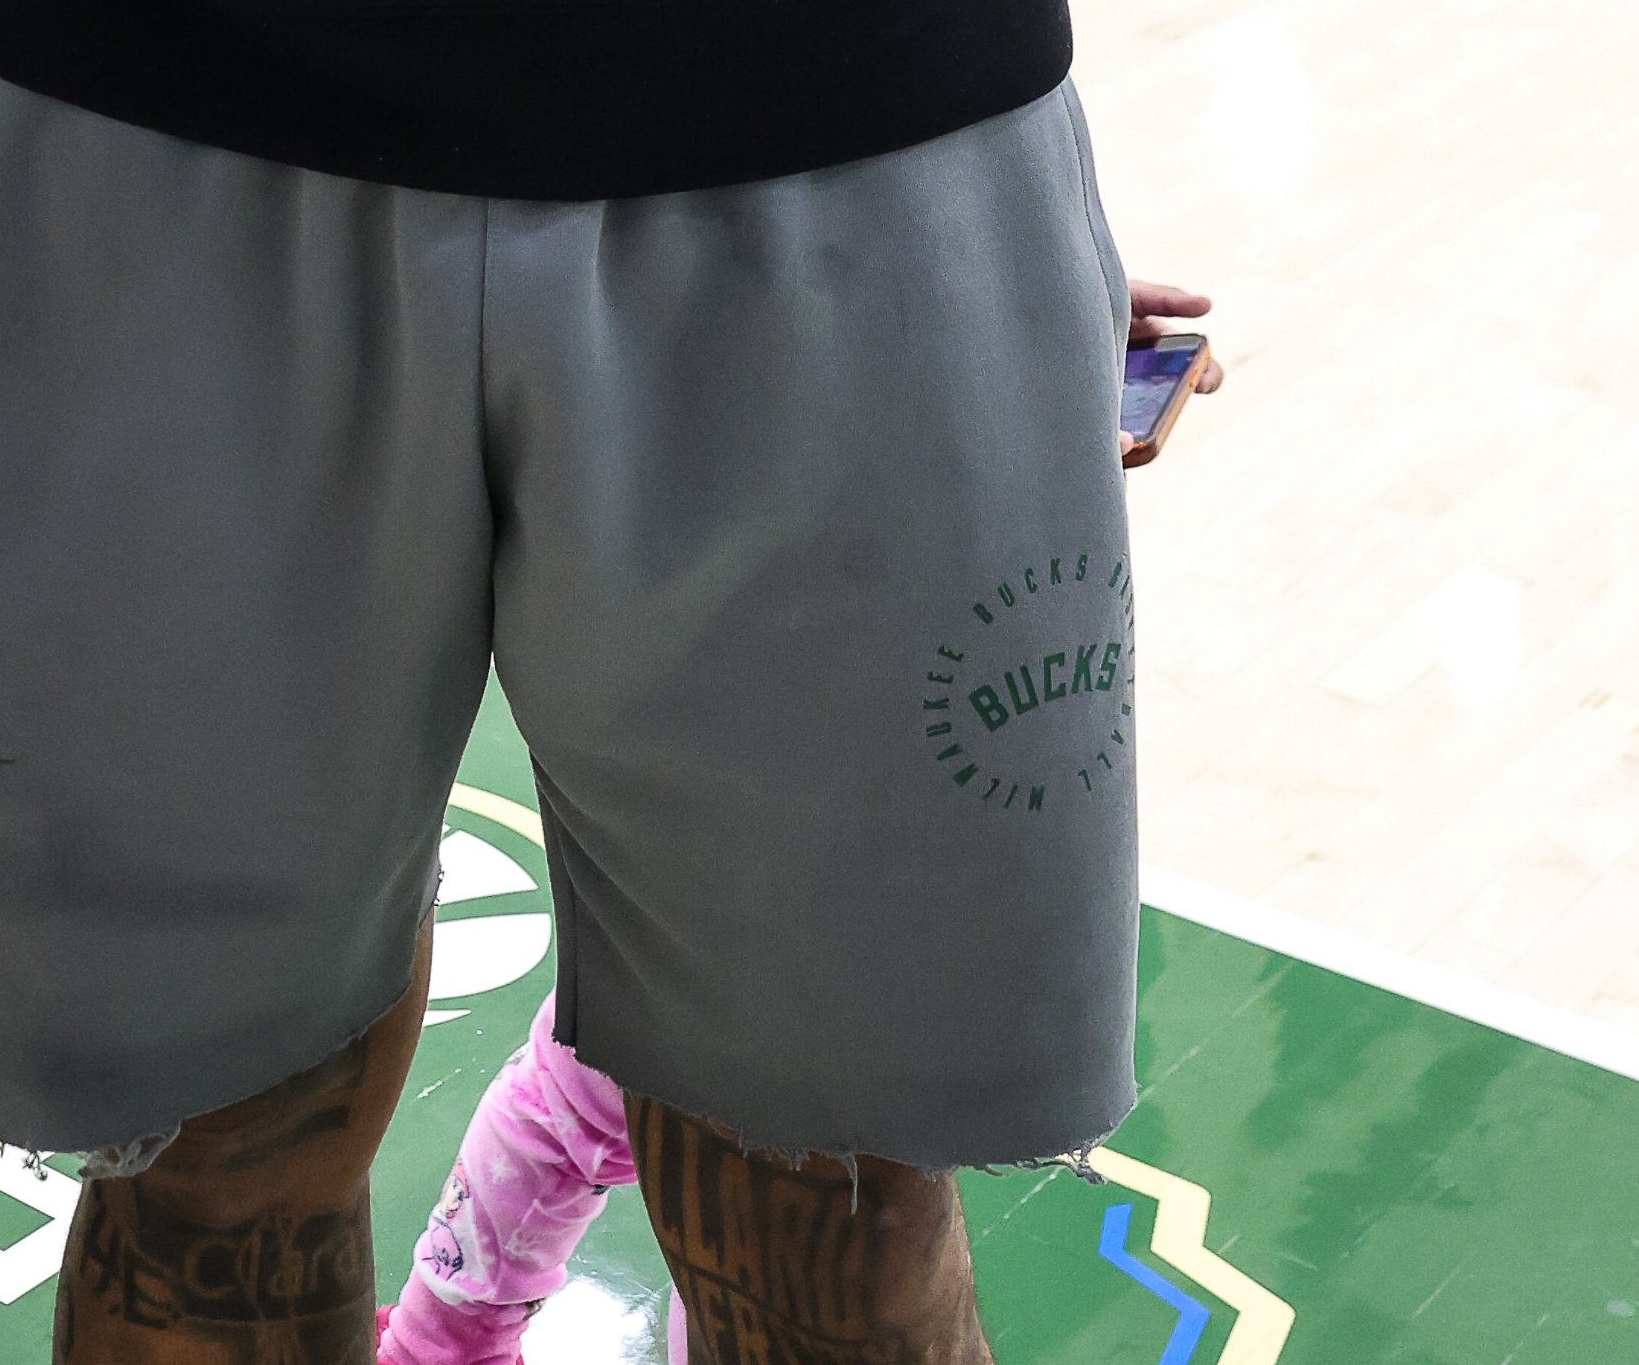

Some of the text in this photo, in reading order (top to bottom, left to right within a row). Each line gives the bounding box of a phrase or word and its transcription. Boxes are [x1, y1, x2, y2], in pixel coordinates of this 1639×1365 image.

[972, 554, 1088, 624] BUCKS
[923, 644, 1045, 811] MILWAUKEE
[968, 643, 1121, 732] BUCKS
